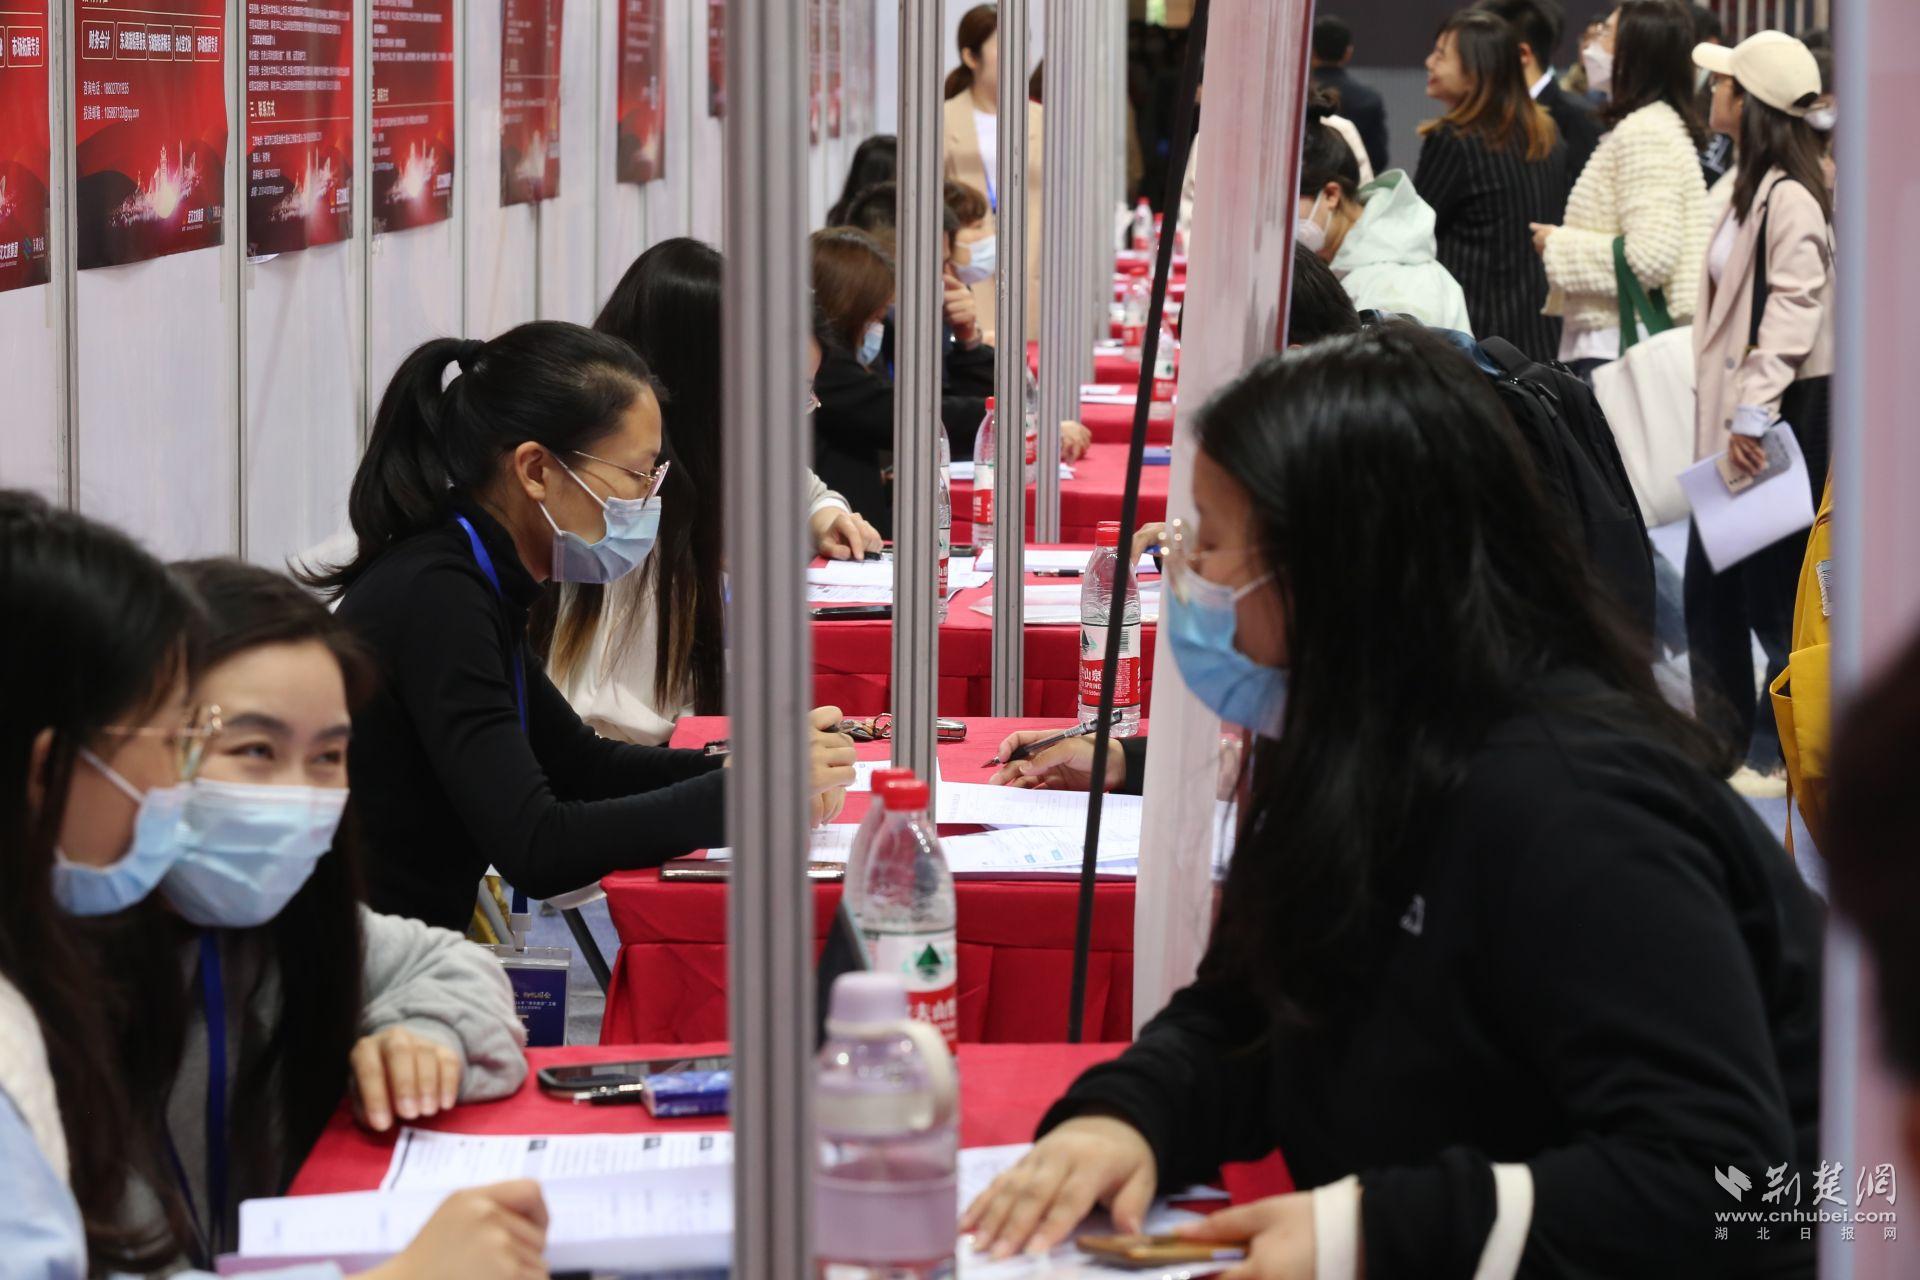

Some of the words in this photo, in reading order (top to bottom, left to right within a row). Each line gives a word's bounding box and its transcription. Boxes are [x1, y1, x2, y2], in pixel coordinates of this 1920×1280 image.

[11, 36, 40, 57] 市场拓展专员
